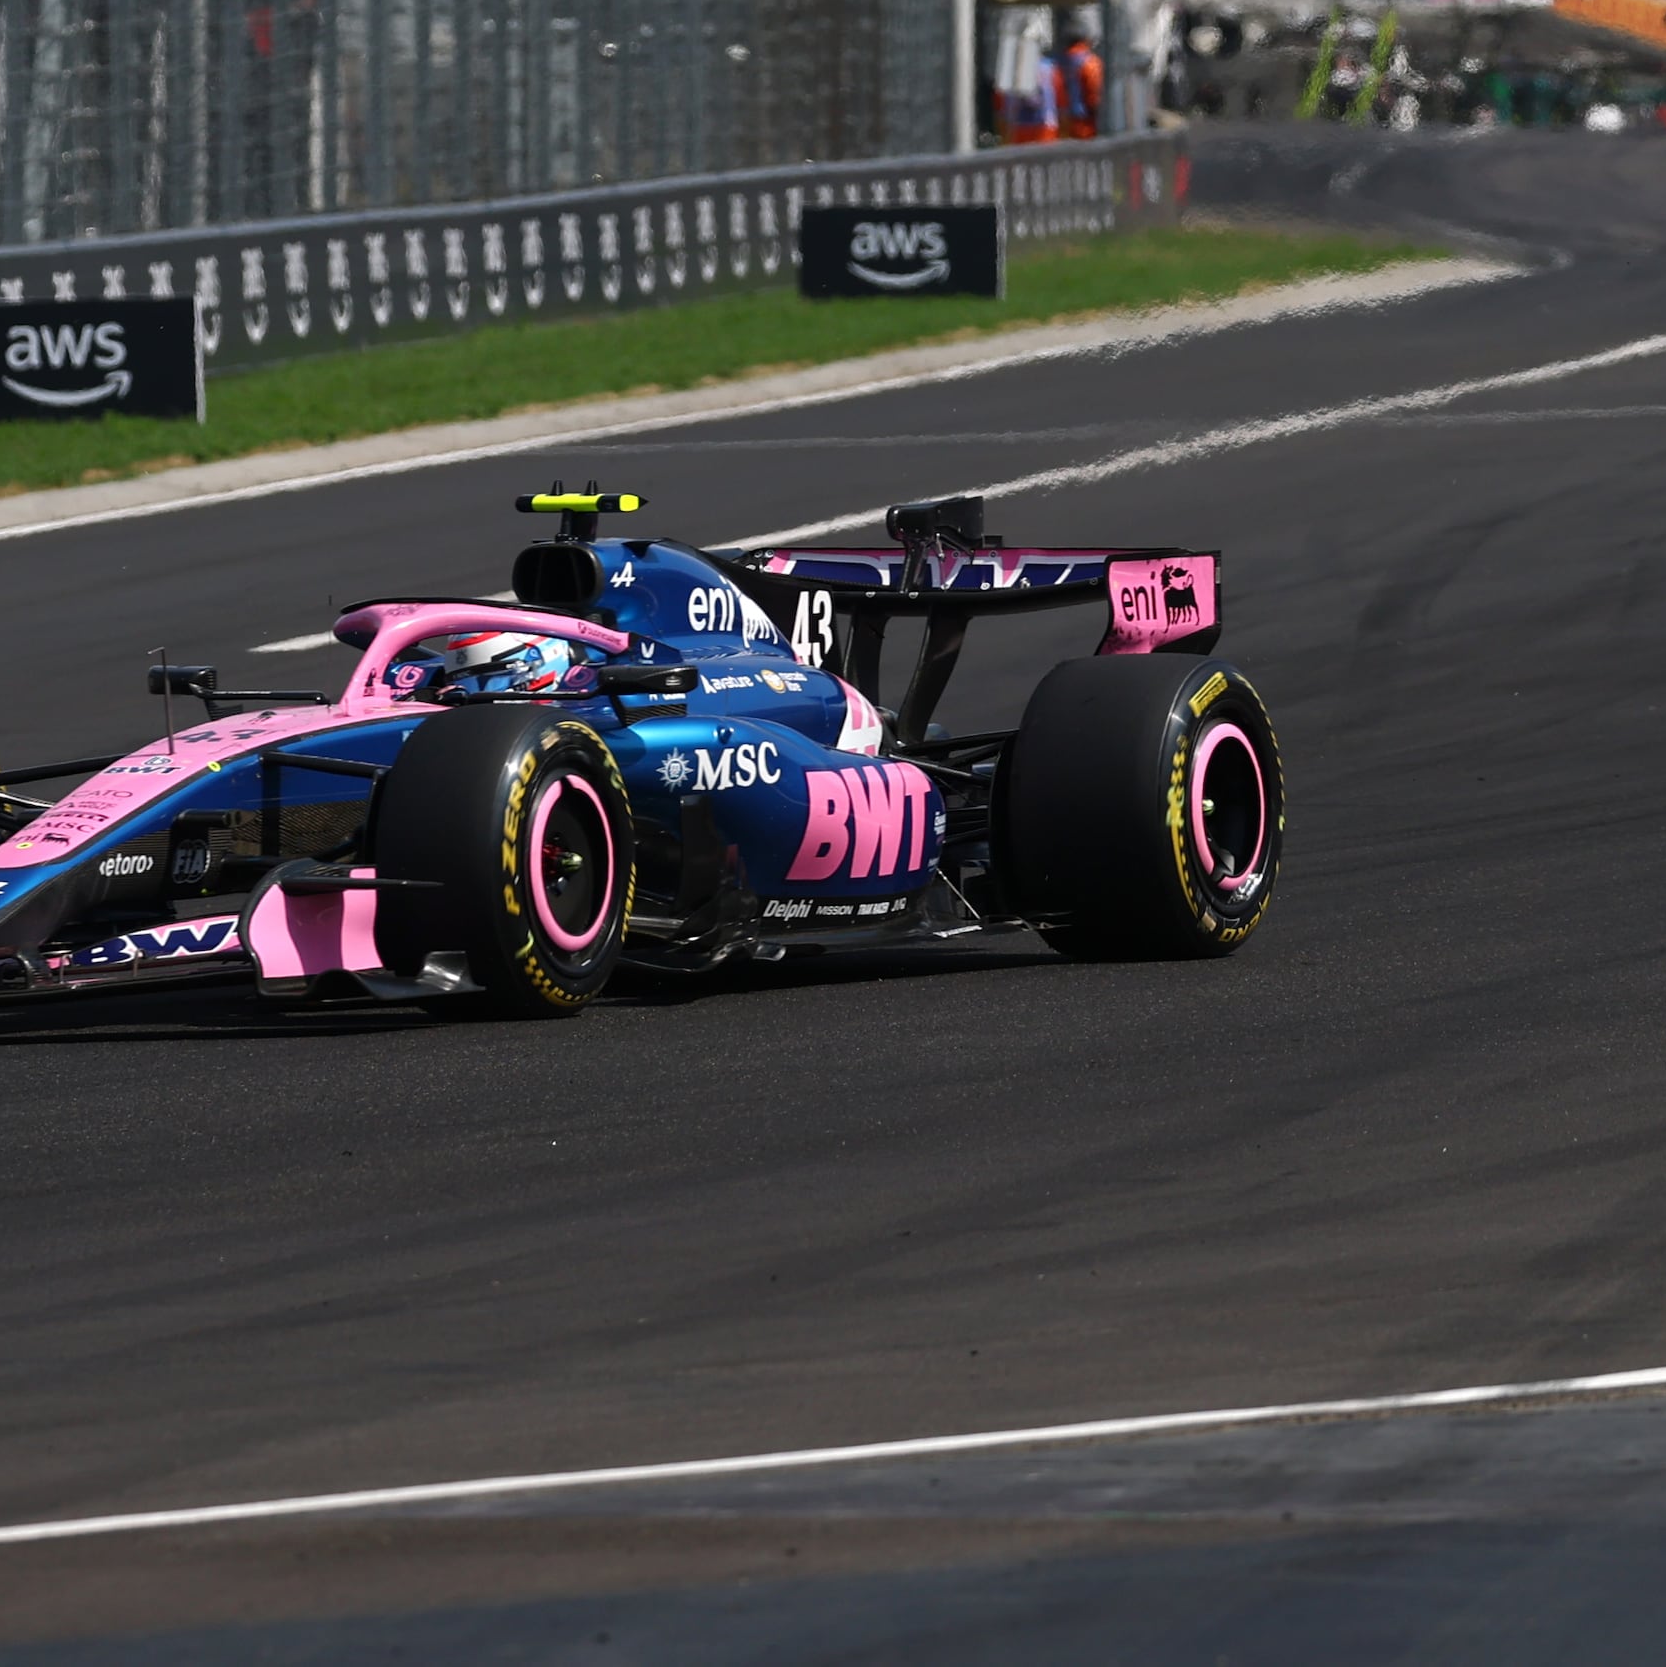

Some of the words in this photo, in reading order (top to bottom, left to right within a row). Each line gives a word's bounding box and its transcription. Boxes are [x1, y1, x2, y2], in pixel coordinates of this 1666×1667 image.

[850, 221, 948, 261] aws
[4, 321, 128, 373] aws
[687, 586, 736, 632] eni
[1121, 572, 1158, 622] eni
[791, 589, 833, 669] 43
[102, 765, 183, 776] BWT
[692, 740, 782, 792] MSC
[41, 821, 96, 834] MSC
[501, 748, 537, 878] ZERO
[785, 761, 932, 881] BWT
[762, 898, 814, 922] Delphi
[71, 919, 240, 967] BW
